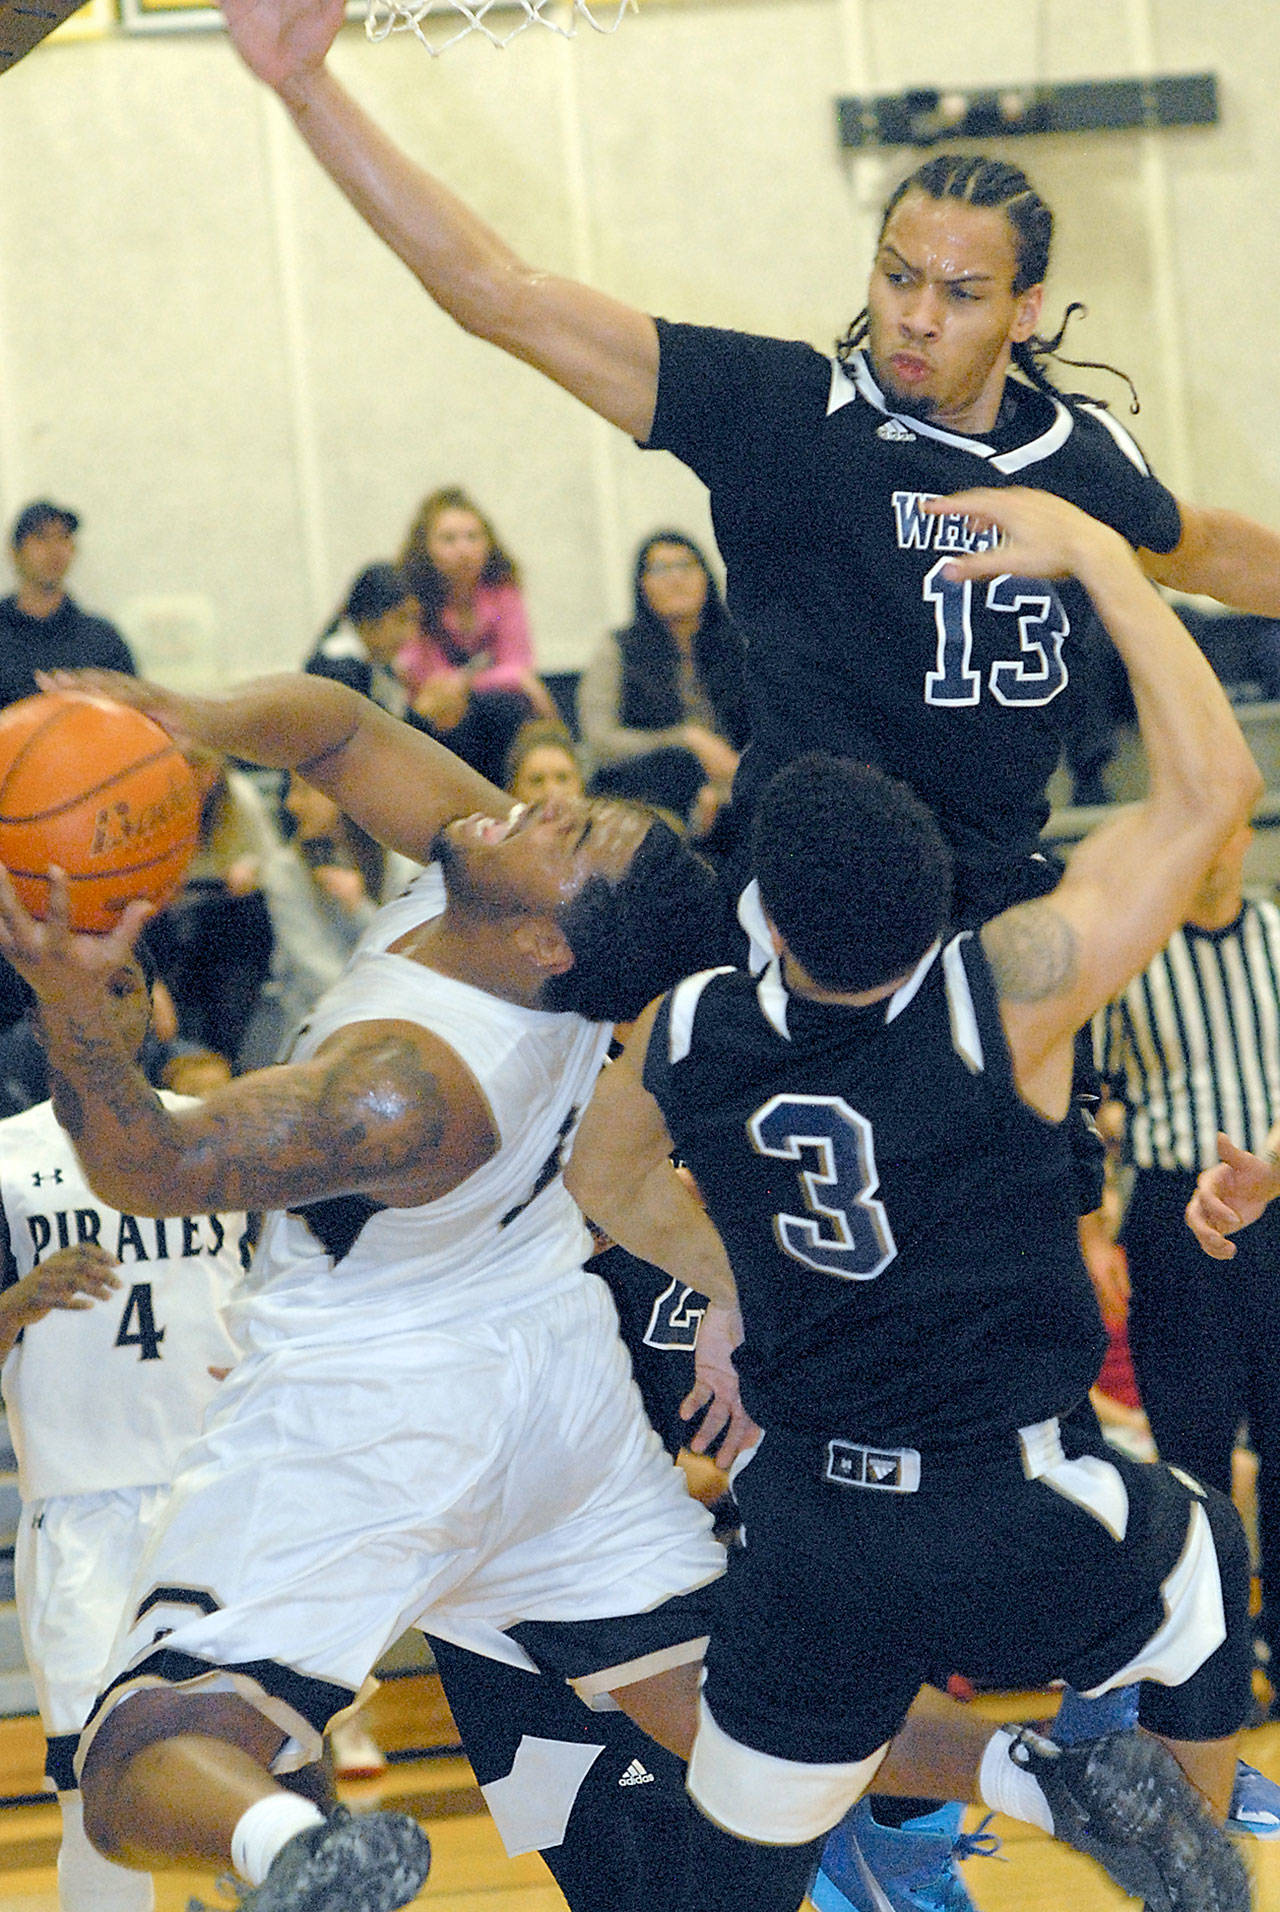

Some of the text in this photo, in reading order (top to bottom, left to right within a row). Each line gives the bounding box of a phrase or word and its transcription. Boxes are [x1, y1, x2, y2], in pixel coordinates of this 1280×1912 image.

[923, 556, 1070, 706] 13
[748, 1093, 898, 1280] 3
[115, 1282, 166, 1361] 4
[618, 1773, 655, 1786] adidas
